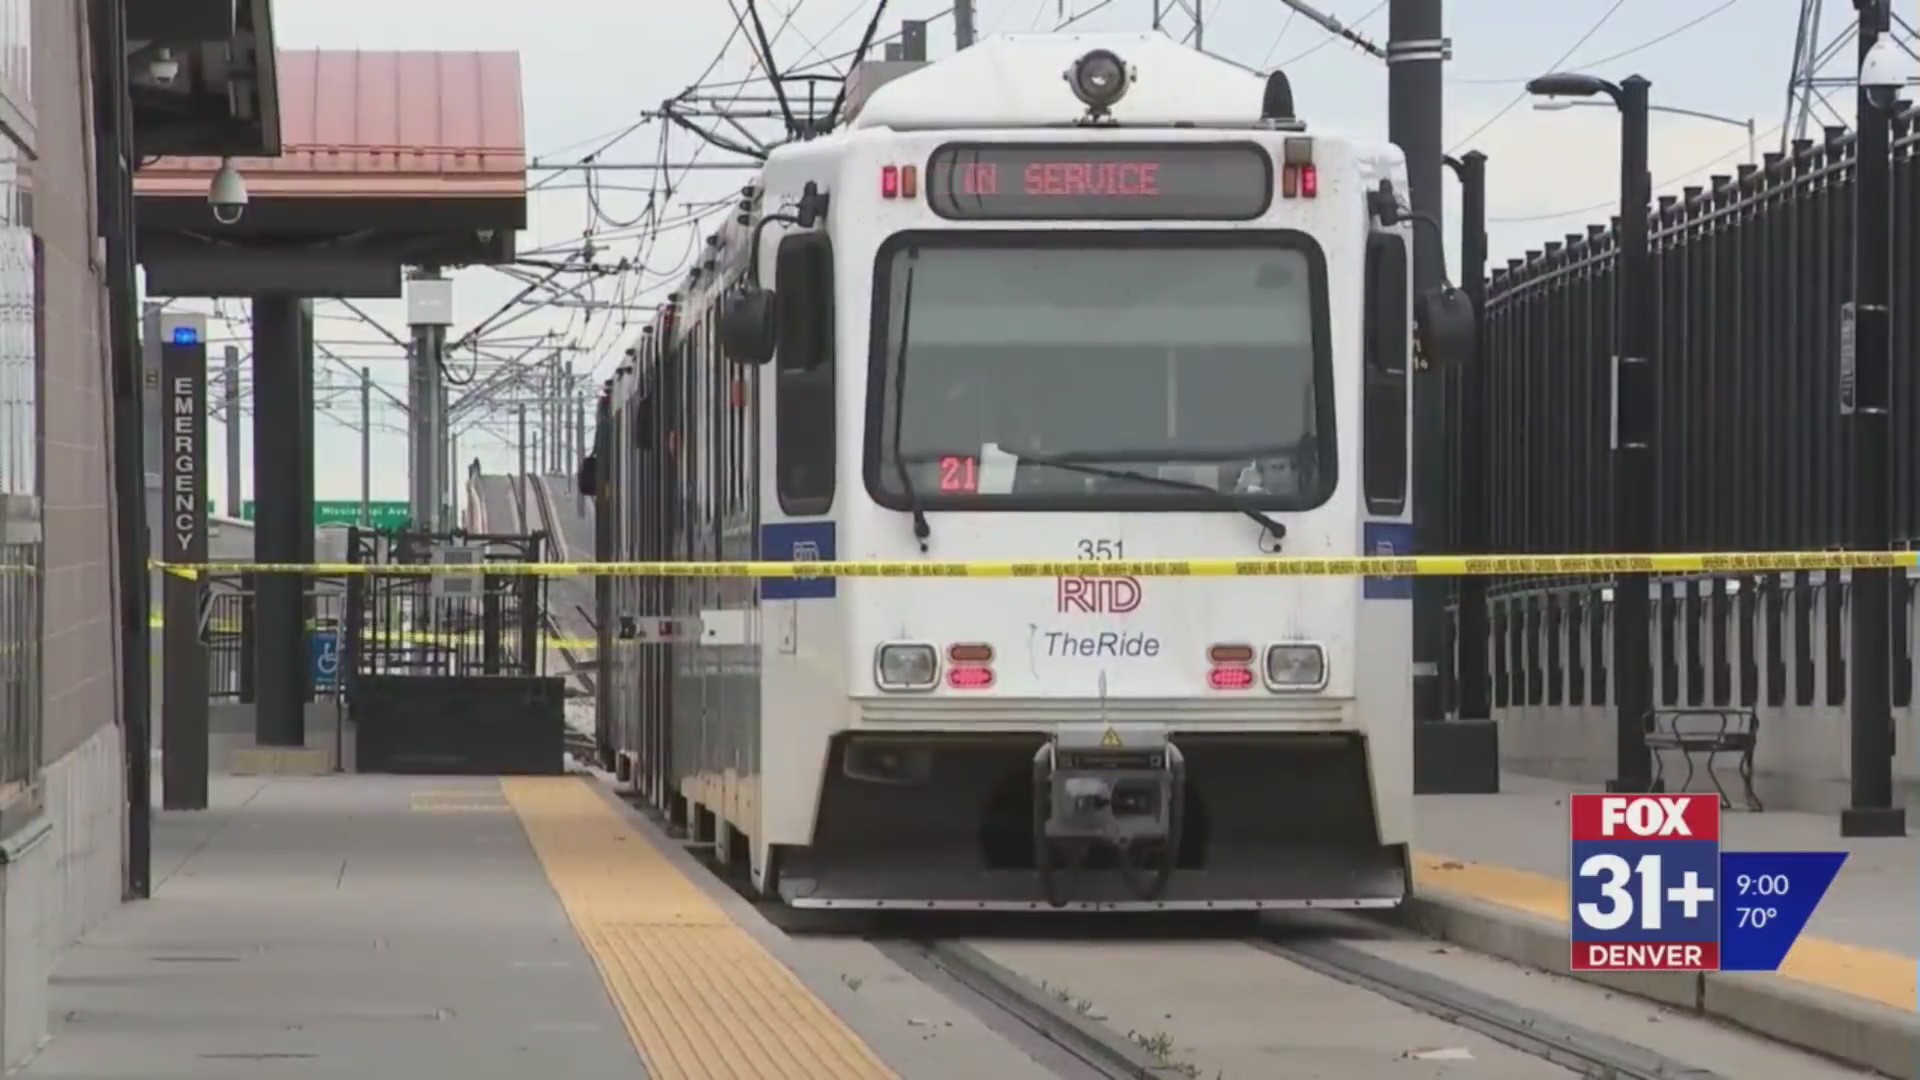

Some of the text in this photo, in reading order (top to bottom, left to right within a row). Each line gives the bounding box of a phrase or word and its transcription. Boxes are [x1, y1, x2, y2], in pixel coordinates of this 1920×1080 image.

[1025, 163, 1160, 194] SERVICE
[175, 377, 193, 550] EMERGENCY
[941, 456, 975, 491] 21
[1078, 539, 1123, 561] 351
[1057, 575, 1142, 613] RTD
[1045, 632, 1160, 657] TheRide
